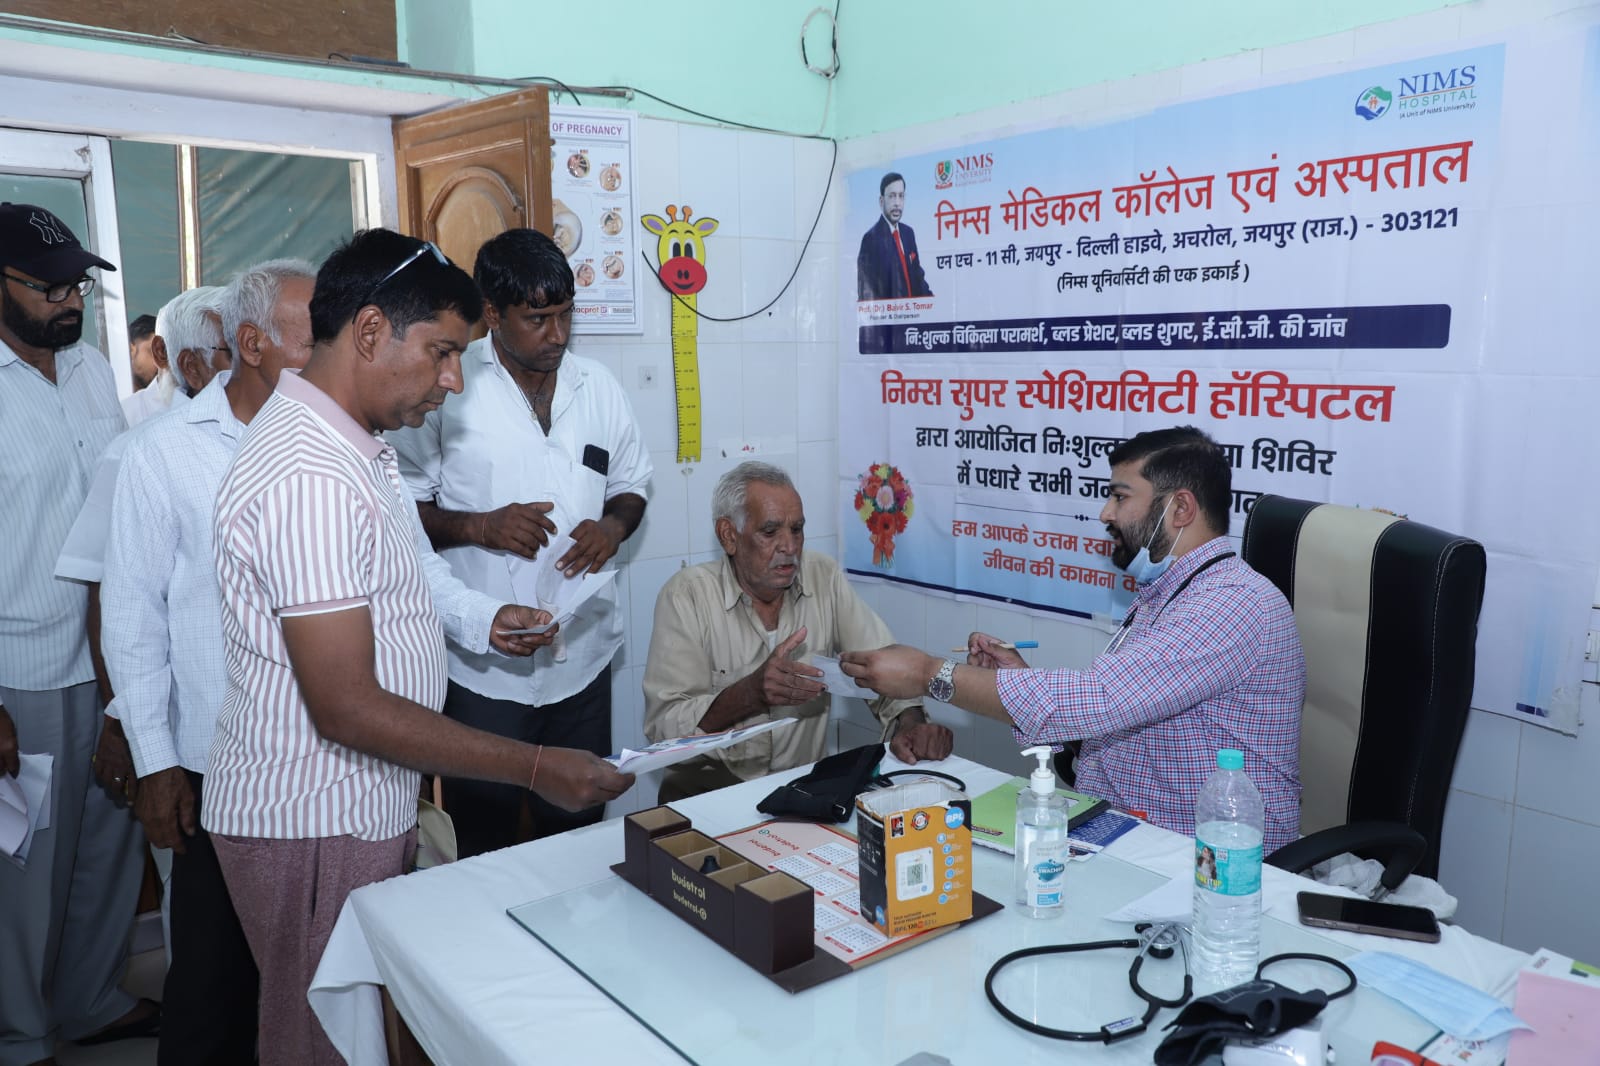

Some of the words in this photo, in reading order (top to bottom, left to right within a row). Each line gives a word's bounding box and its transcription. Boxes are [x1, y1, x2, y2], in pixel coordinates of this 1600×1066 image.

[1398, 65, 1475, 97] NIMS
[1399, 89, 1477, 110] HOSPITAL
[1407, 110, 1418, 118] Unit
[552, 122, 564, 132] OF
[567, 123, 622, 136] PREGNANCY
[956, 152, 993, 173] NIMS
[934, 200, 991, 240] निम्स
[1001, 186, 1102, 231] मेडिकल
[1112, 166, 1215, 217] कॉलेज
[1227, 153, 1279, 213] एवं
[1294, 140, 1473, 198] अस्पताल
[936, 255, 952, 269] एन
[955, 252, 973, 268] एच
[986, 251, 997, 265] 11
[1001, 243, 1020, 265] सी,
[1024, 243, 1062, 266] जयपुर
[1076, 233, 1119, 258] दिल्ली
[1123, 229, 1166, 254] हाइवे,
[1172, 224, 1237, 249] अचरोल,
[1243, 222, 1296, 248] जयपुर
[1302, 215, 1358, 243] (राज.)
[1381, 208, 1458, 233] 303121
[1057, 272, 1088, 293] (निम्स
[1091, 265, 1150, 293] यूनिवर्सिटी
[1153, 265, 1171, 284] की
[1174, 267, 1198, 282] एक
[913, 302, 933, 310] Tomar
[952, 325, 999, 345] चिकित्सा
[1000, 321, 1048, 345] परामर्श,
[1051, 325, 1081, 342] ब्लड
[1082, 320, 1119, 344] प्रेशर,
[1121, 323, 1154, 341] ब्लड
[1157, 322, 1199, 346] शुगर,
[1279, 313, 1305, 338] की
[1307, 313, 1348, 338] जांच
[881, 369, 942, 406] निम्स
[949, 379, 1008, 421] सुपर
[1016, 369, 1199, 414] स्पेशियलिटी
[1209, 370, 1396, 422] हॉस्पिटल
[916, 427, 948, 448] द्वारा
[954, 424, 1037, 454] आयोजित
[1252, 437, 1337, 475] शिविर
[957, 460, 970, 485] में
[976, 464, 1021, 491] पधारे
[1028, 467, 1072, 496] सभी
[952, 520, 977, 538] हम
[982, 523, 1029, 545] आपके
[1033, 530, 1078, 552] उत्तम
[983, 548, 1025, 574] जीवन
[1030, 556, 1054, 578] की
[1059, 563, 1117, 590] कामना
[671, 867, 706, 900] budetrol
